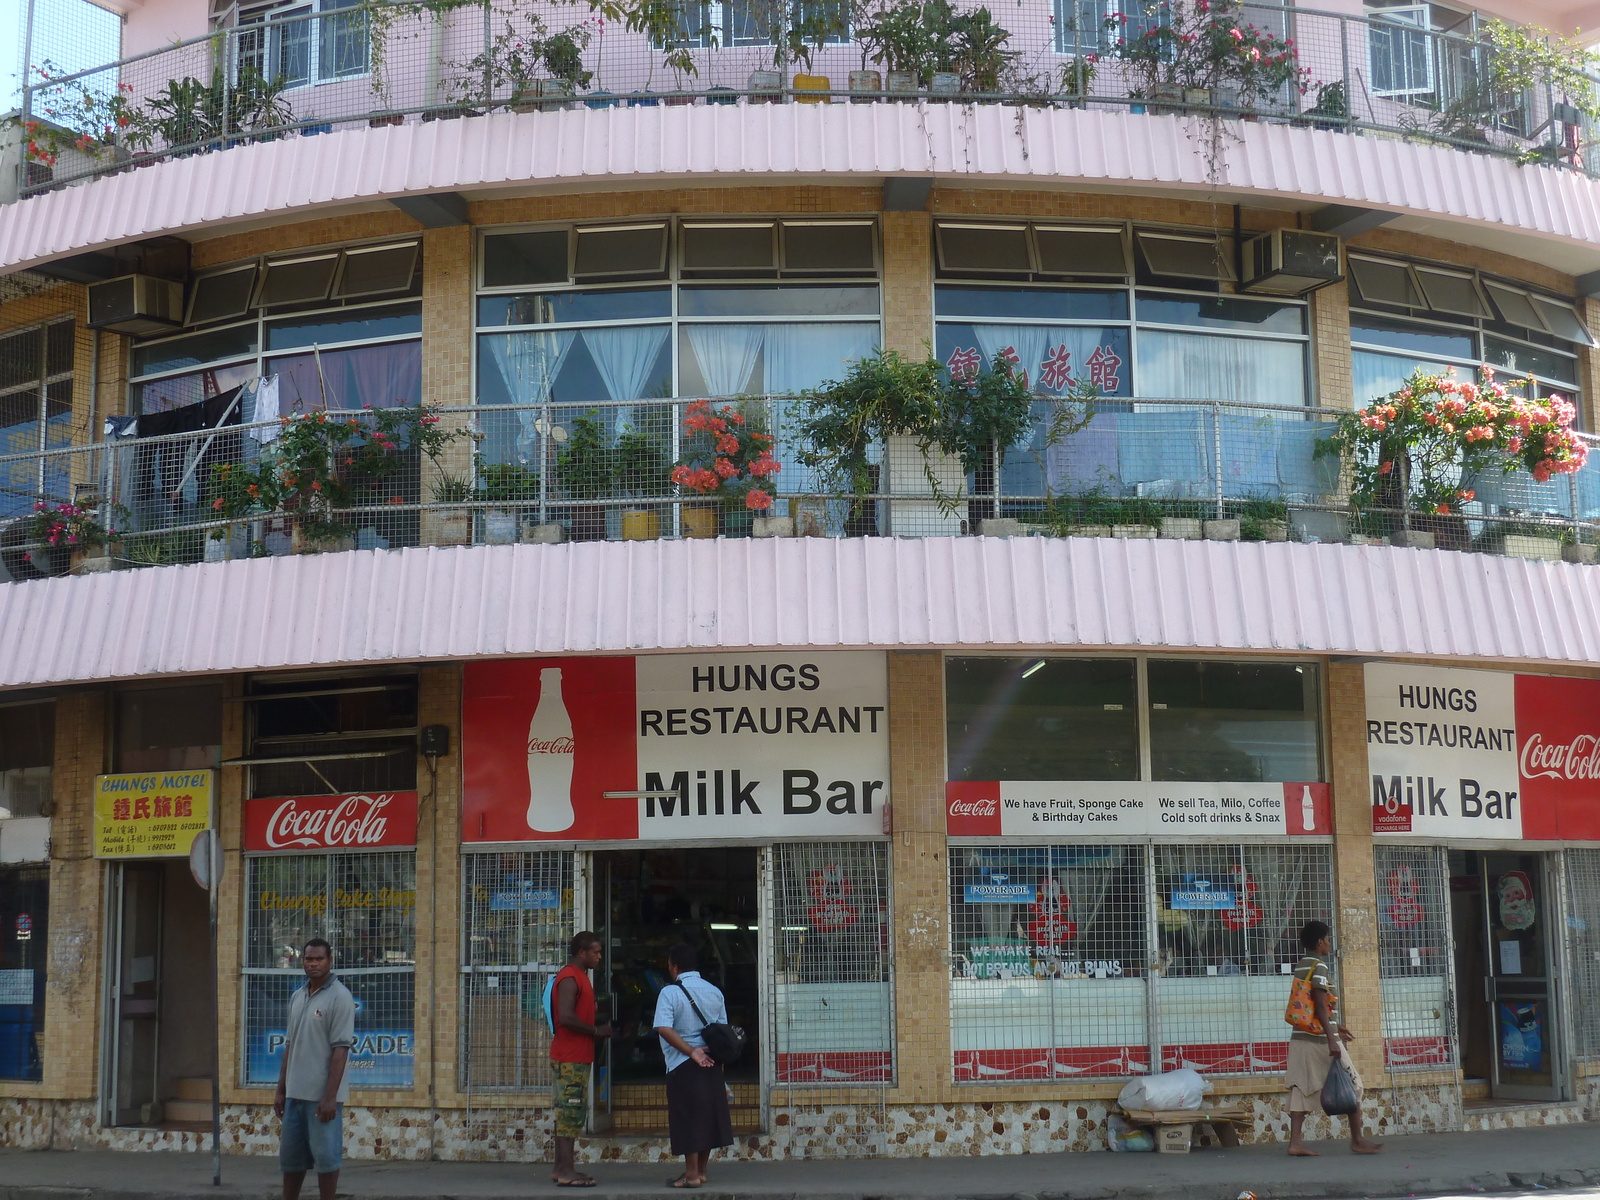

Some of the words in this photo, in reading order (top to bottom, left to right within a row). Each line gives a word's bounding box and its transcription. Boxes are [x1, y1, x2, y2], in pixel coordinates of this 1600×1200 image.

[692, 663, 820, 692] HUNGS
[1399, 685, 1477, 712] HUNGS
[641, 706, 884, 736] RESTAURANT
[1366, 720, 1514, 751] RESTAURANT
[528, 737, 575, 754] Coca-Cola
[101, 777, 157, 793] CHUNGS
[160, 774, 206, 789] MOTEL
[645, 769, 762, 817] Milk
[783, 769, 884, 815] Bar
[1372, 774, 1449, 816] Milk
[1459, 778, 1517, 820] Bar
[949, 799, 997, 816] Coca-Cola
[1004, 799, 1020, 809] We
[1023, 799, 1047, 809] have
[1050, 799, 1076, 810] Fruit,
[1078, 799, 1117, 811] Sponge
[1119, 798, 1144, 808] Cake
[1158, 797, 1175, 808] We
[1177, 797, 1196, 808] sell
[1198, 797, 1218, 810] Tea,
[1221, 797, 1246, 810] Milo,
[1248, 797, 1281, 808] Coffee
[266, 794, 394, 848] Coca-Cola
[1031, 812, 1040, 822] &
[1042, 812, 1085, 824] Birthday
[1087, 812, 1118, 822] Cakes
[1161, 812, 1185, 823] Cold
[1188, 812, 1208, 823] soft
[1209, 812, 1242, 823] drinks
[1244, 812, 1253, 822] &
[1255, 812, 1280, 823] Snax
[1378, 815, 1407, 823] vodafone
[970, 886, 1028, 895] POWERADE
[1177, 892, 1226, 901] POWERADE
[970, 946, 990, 957] WE
[994, 945, 1032, 956] MAKE
[962, 963, 984, 977] HOT
[1061, 961, 1082, 975] HOT
